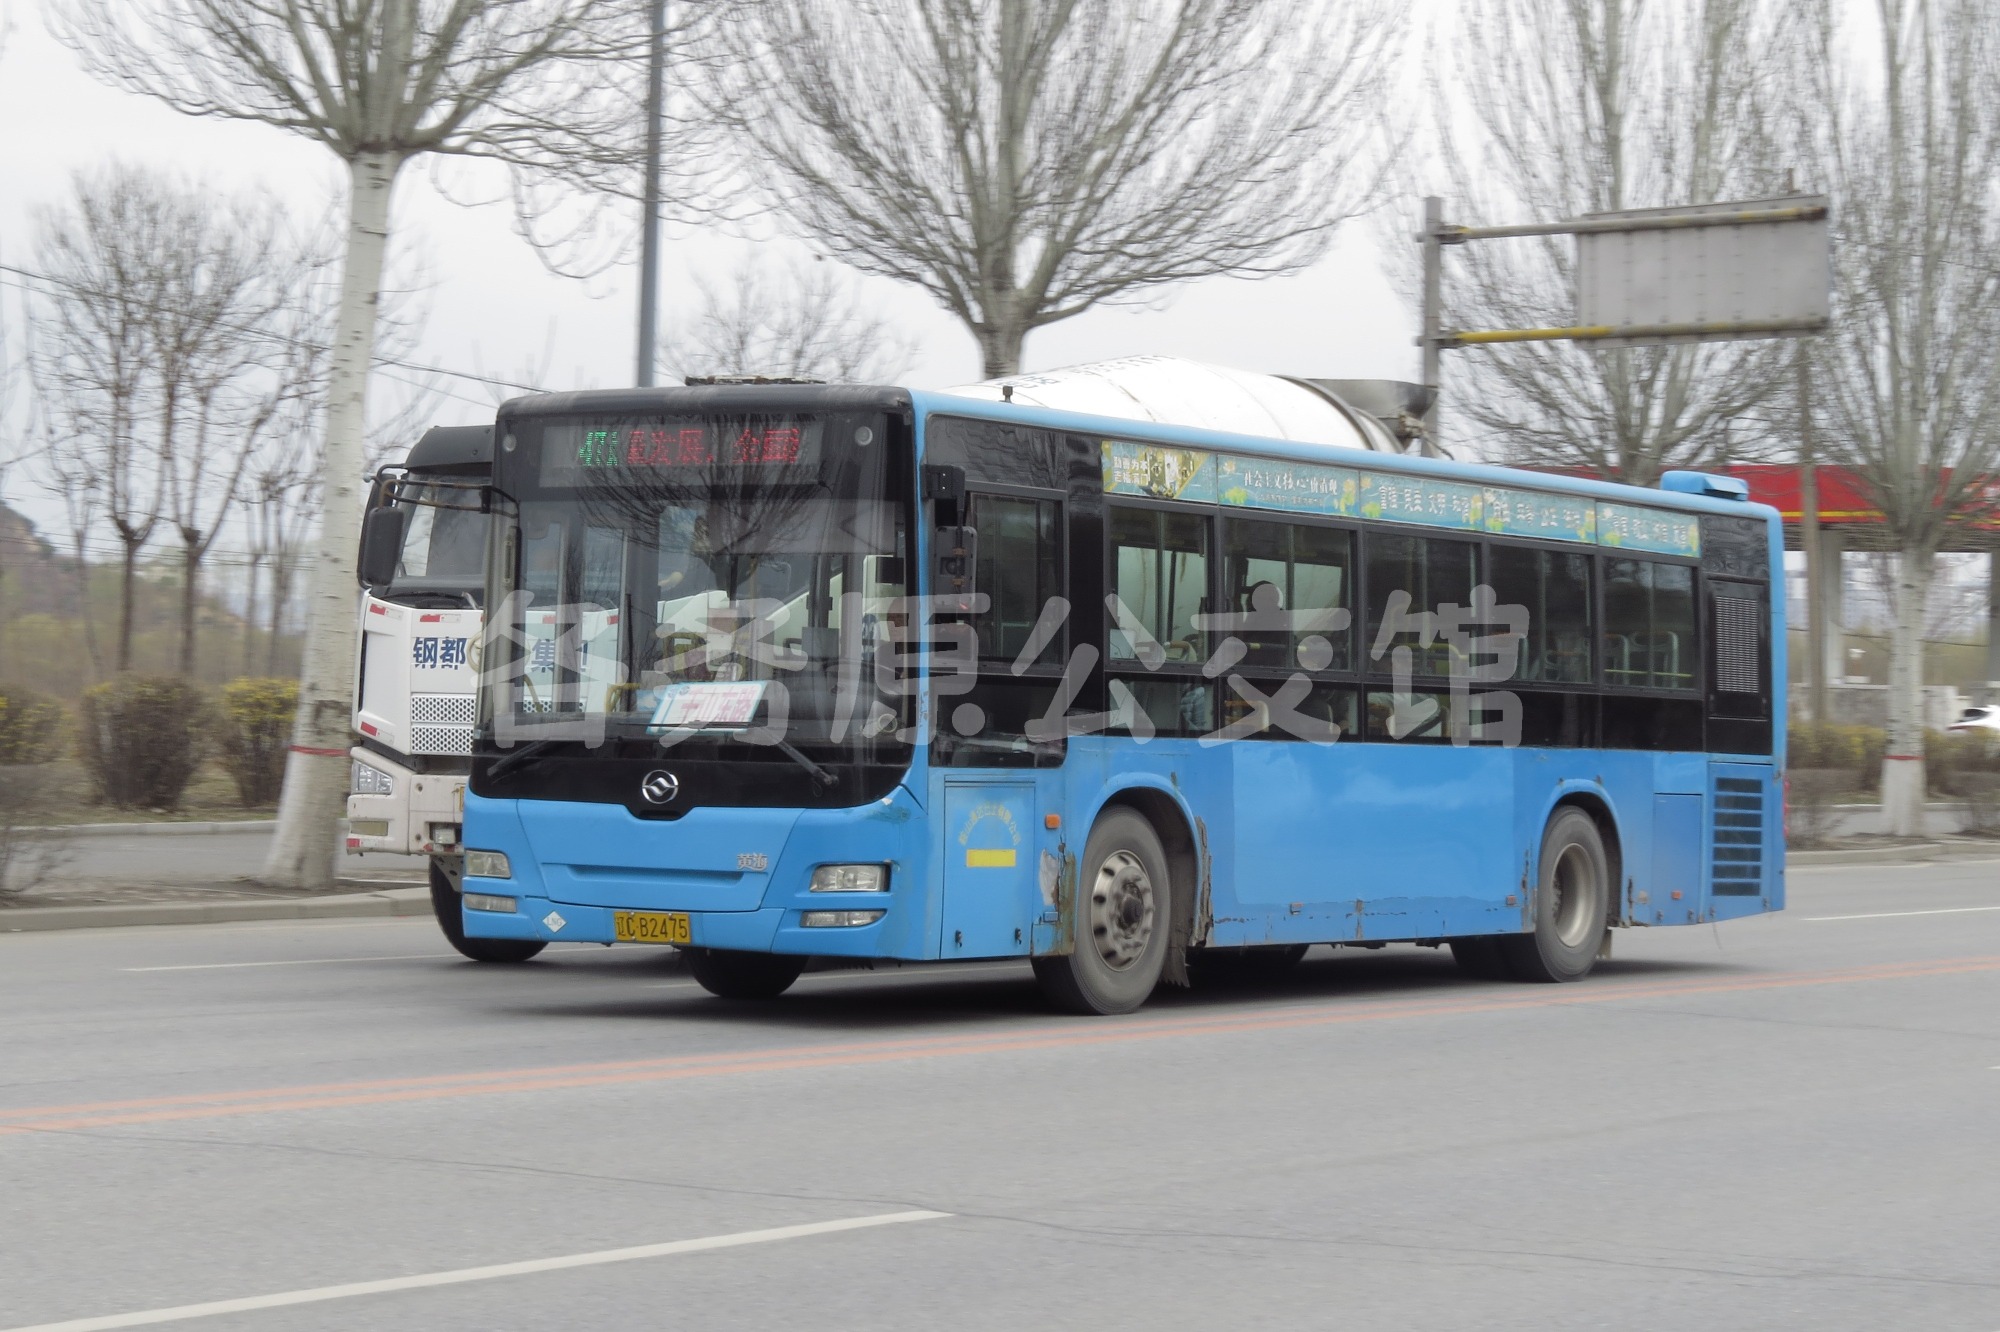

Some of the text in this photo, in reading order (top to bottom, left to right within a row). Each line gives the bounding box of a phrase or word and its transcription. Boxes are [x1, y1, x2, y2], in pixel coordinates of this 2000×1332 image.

[412, 636, 467, 671] 钢都
[736, 852, 768, 872] 黄海
[546, 916, 564, 927] LNG
